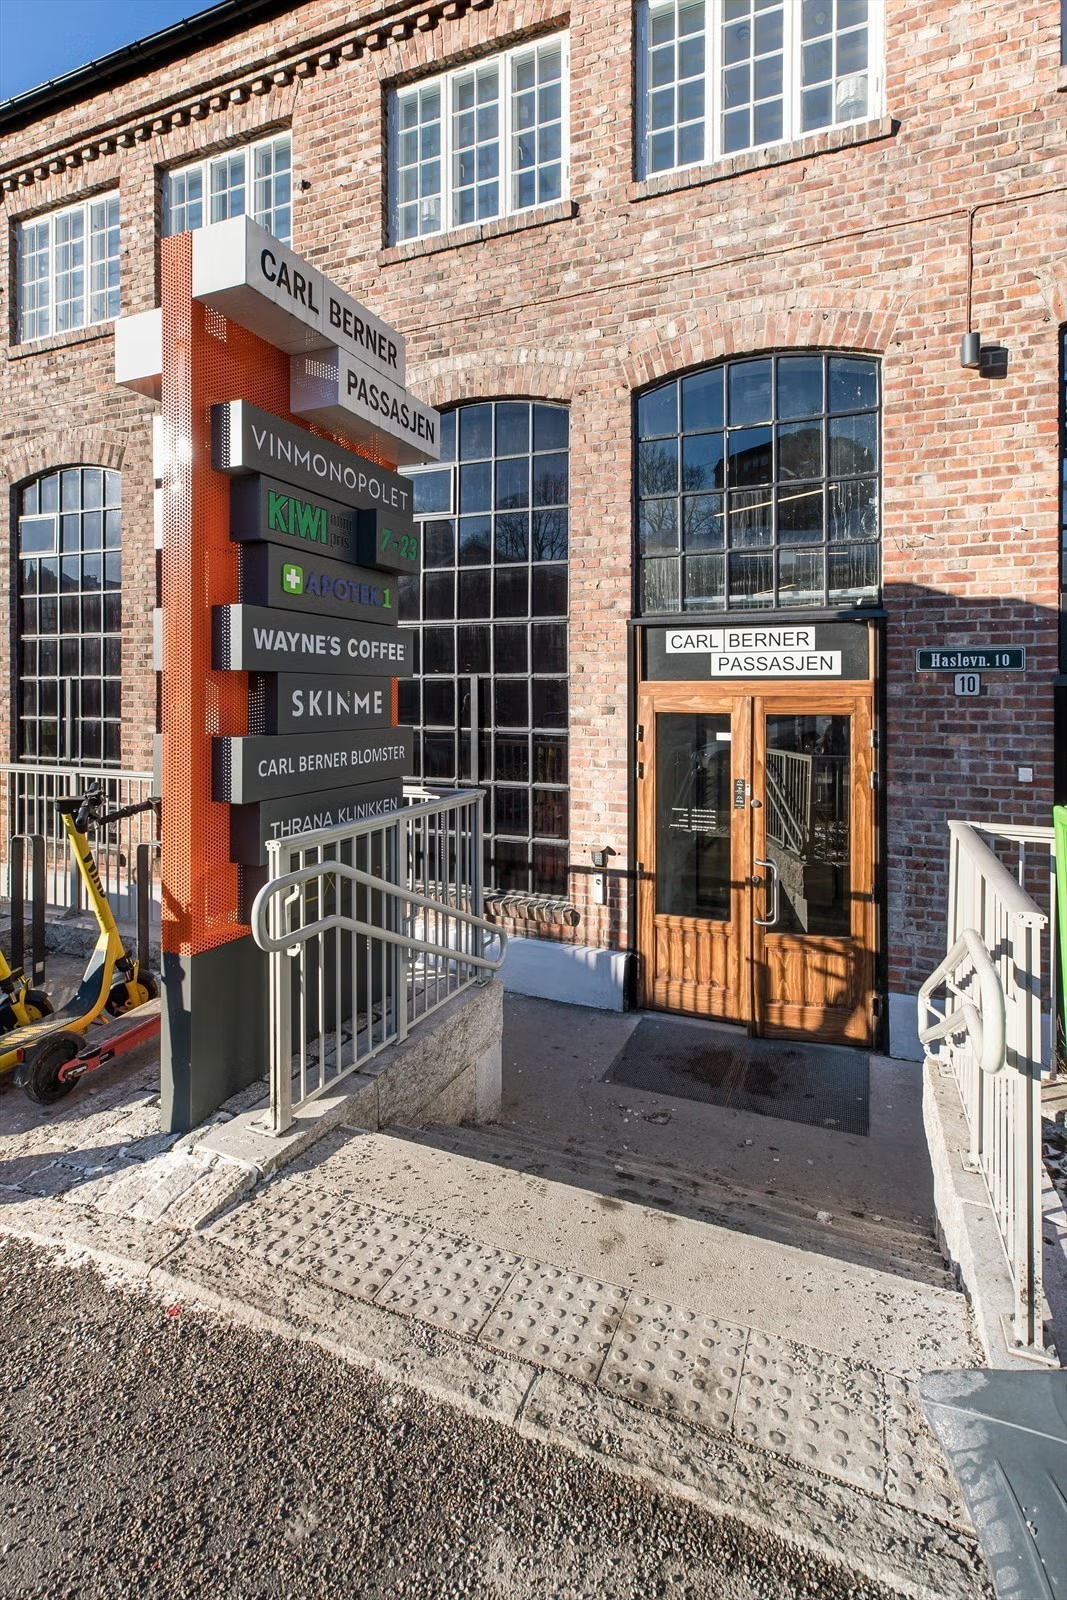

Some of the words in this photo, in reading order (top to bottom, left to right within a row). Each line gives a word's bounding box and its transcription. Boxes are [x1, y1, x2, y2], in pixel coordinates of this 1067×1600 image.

[261, 249, 319, 315] CARL
[330, 297, 397, 369] BERNER
[348, 369, 434, 444] PASSASJEN
[252, 424, 408, 510] VINMONOPOLET
[268, 490, 329, 545] KIWI
[306, 571, 380, 608] APOTEK
[382, 588, 391, 608] 1
[253, 628, 340, 656] WAYNE'S
[348, 638, 404, 661] COFFEE
[671, 634, 718, 649] CARL
[729, 631, 810, 648] BERNER
[719, 656, 833, 671] PASSASJEN
[931, 653, 990, 667] Haslevn.
[995, 654, 1010, 667] 10
[959, 676, 976, 692] 10
[258, 758, 294, 777] CARL
[299, 751, 347, 772] BERNER
[351, 746, 405, 765] BLOMSTER
[270, 811, 333, 838] THRANA
[339, 797, 397, 823] KLINIKKEN
